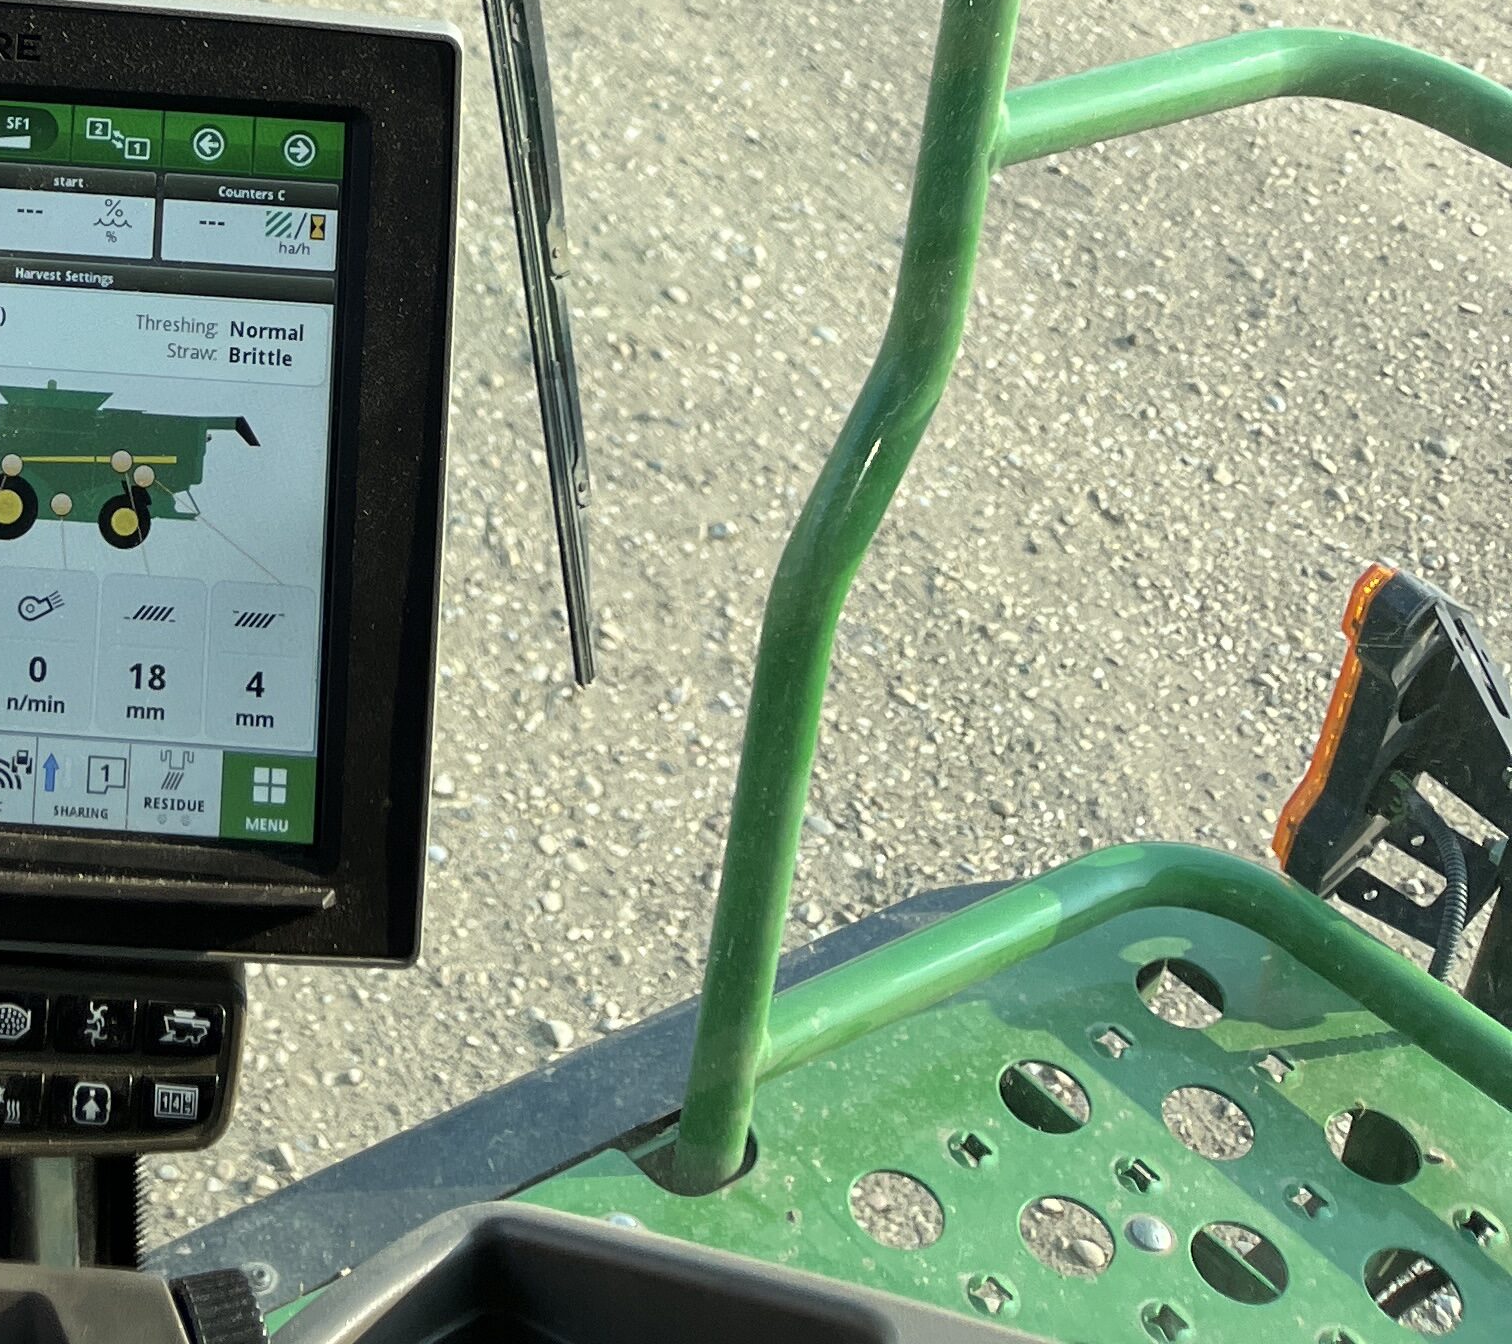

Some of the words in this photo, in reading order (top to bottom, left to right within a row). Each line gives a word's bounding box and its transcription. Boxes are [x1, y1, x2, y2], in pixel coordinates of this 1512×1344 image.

[6, 116, 31, 131] SF1
[53, 175, 84, 189] start
[218, 185, 274, 201] Counters
[277, 189, 286, 201] C
[278, 241, 311, 256] ha/h
[15, 267, 62, 281] Harvest
[65, 269, 115, 287] Settings
[229, 320, 304, 342] Normal
[228, 346, 293, 368] Brittle
[28, 655, 48, 683] 0
[128, 662, 167, 691] 18
[245, 671, 266, 698] 4
[6, 694, 66, 714] n/min
[126, 703, 165, 721] mm
[235, 712, 275, 729] mm
[53, 805, 109, 820] SHARING
[143, 796, 205, 813] RESIDUE
[245, 816, 289, 833] MENU
